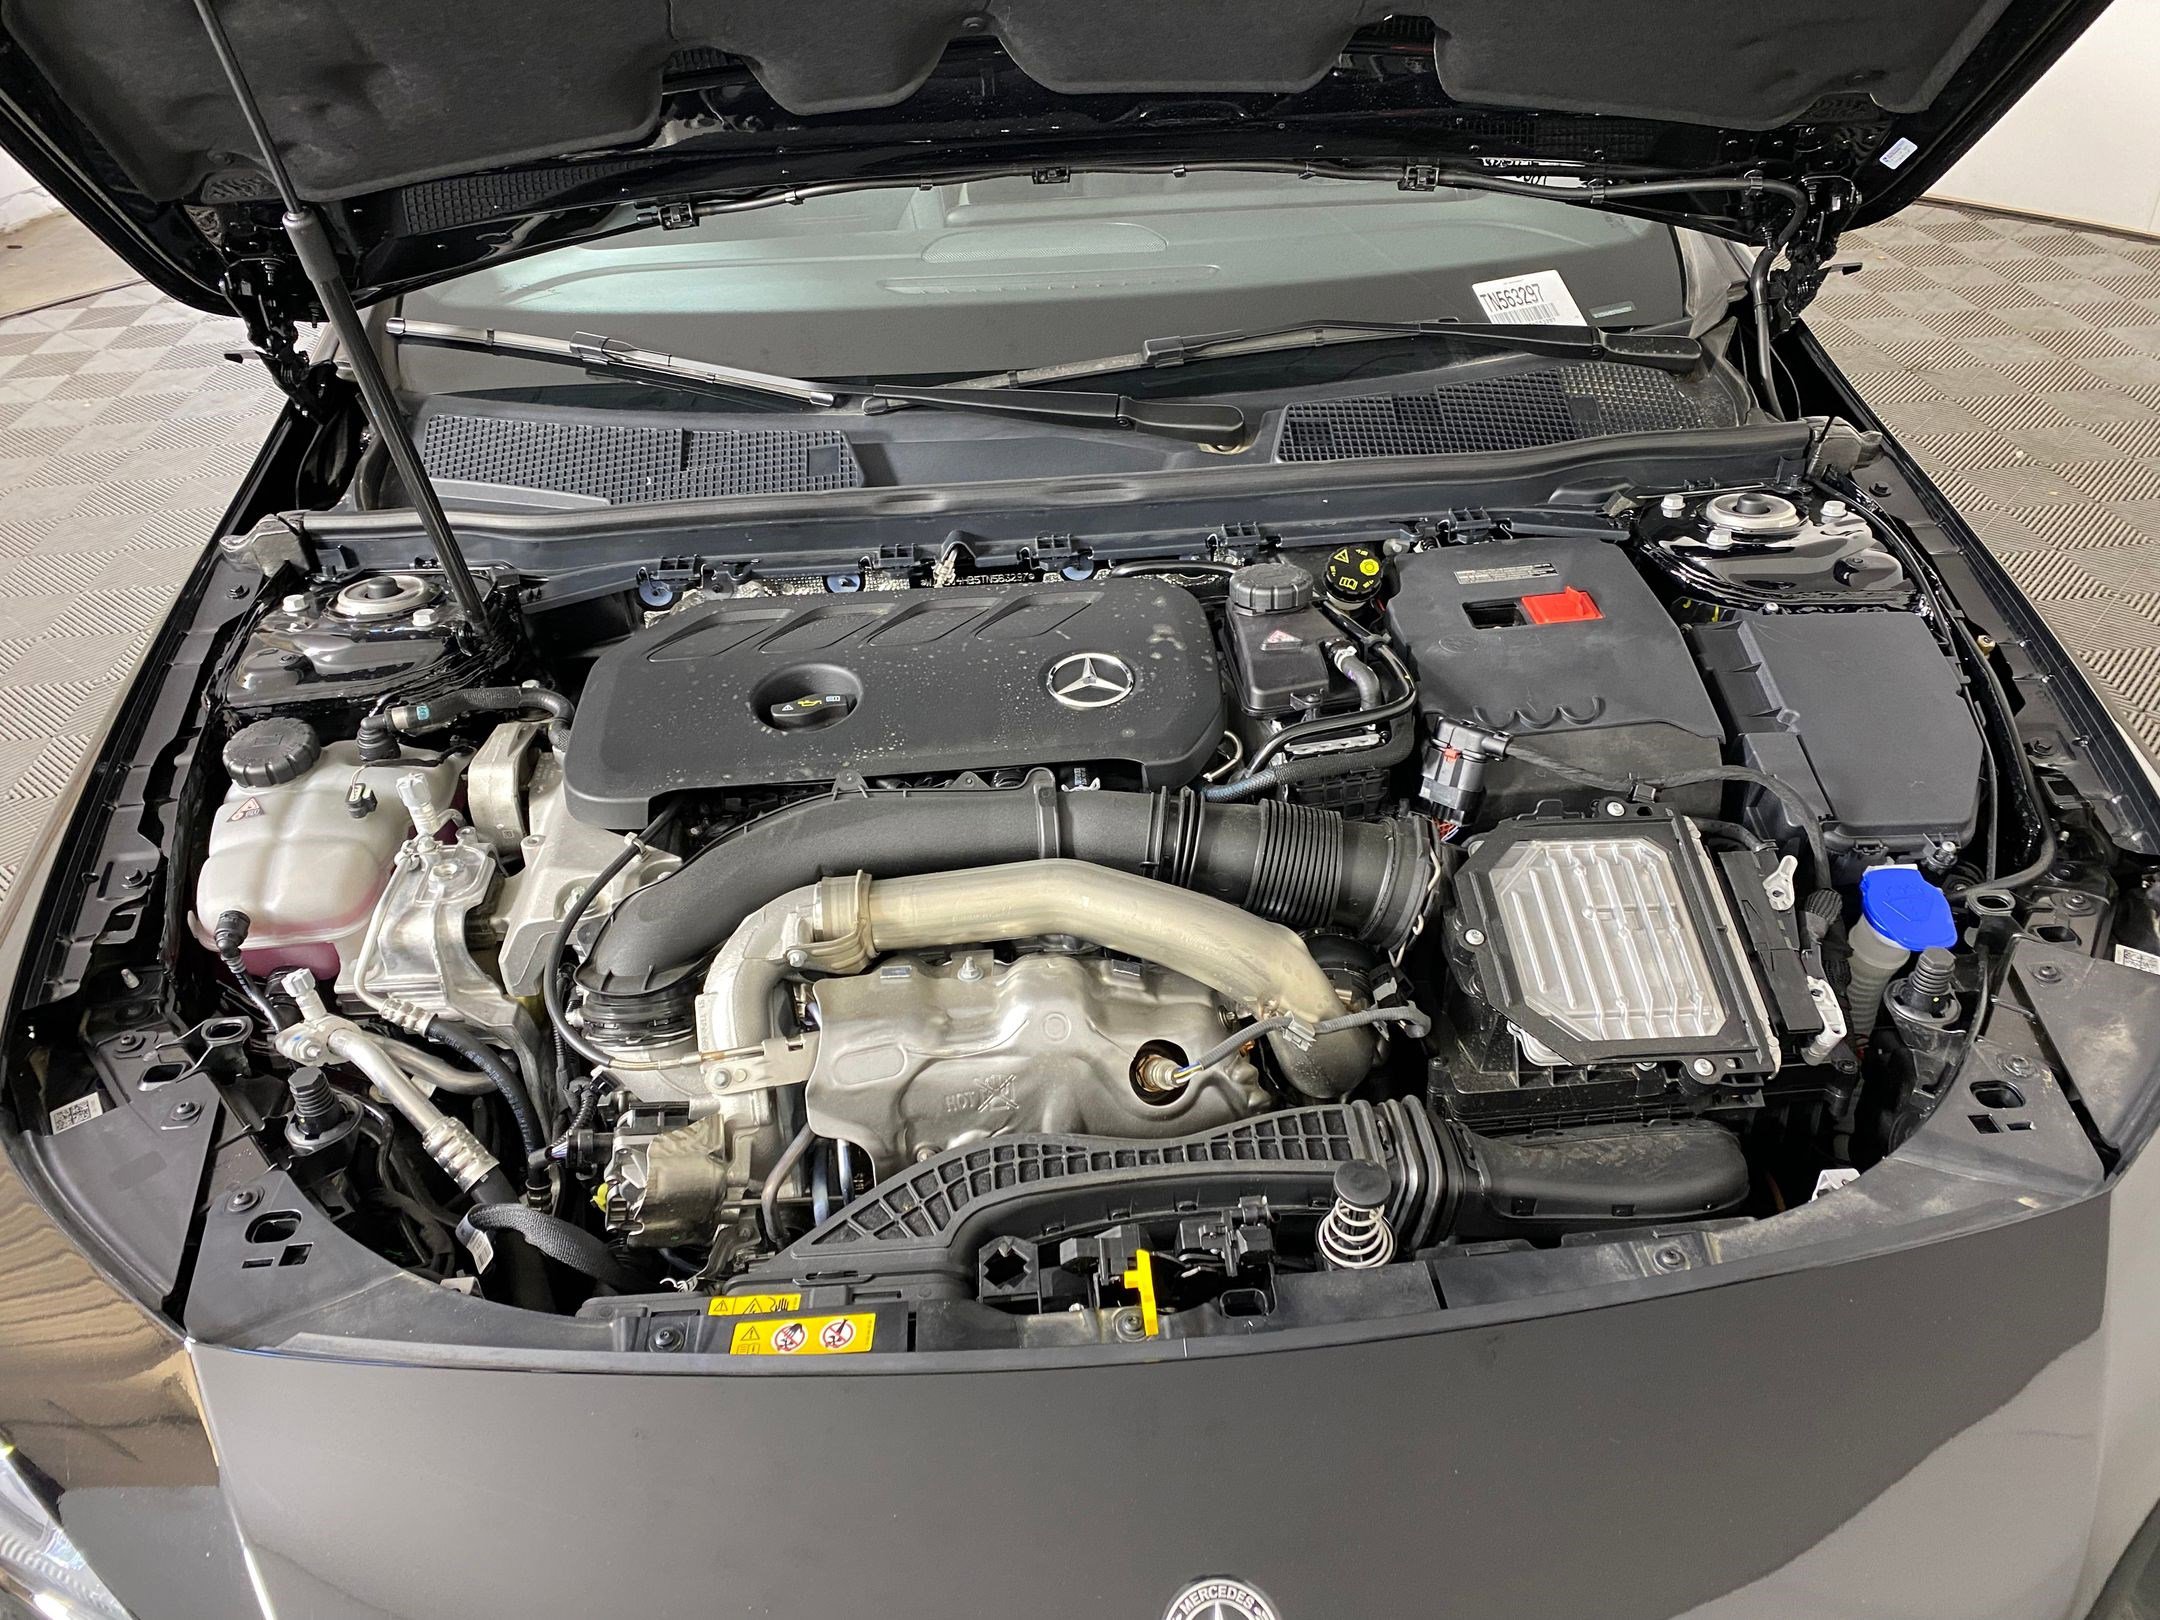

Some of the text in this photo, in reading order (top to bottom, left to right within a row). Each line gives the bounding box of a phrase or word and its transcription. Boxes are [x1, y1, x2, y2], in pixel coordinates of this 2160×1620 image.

[1480, 283, 1545, 313] TN563297
[945, 1091, 975, 1112] HOT
[1180, 1585, 1255, 1615] MERCEDES
